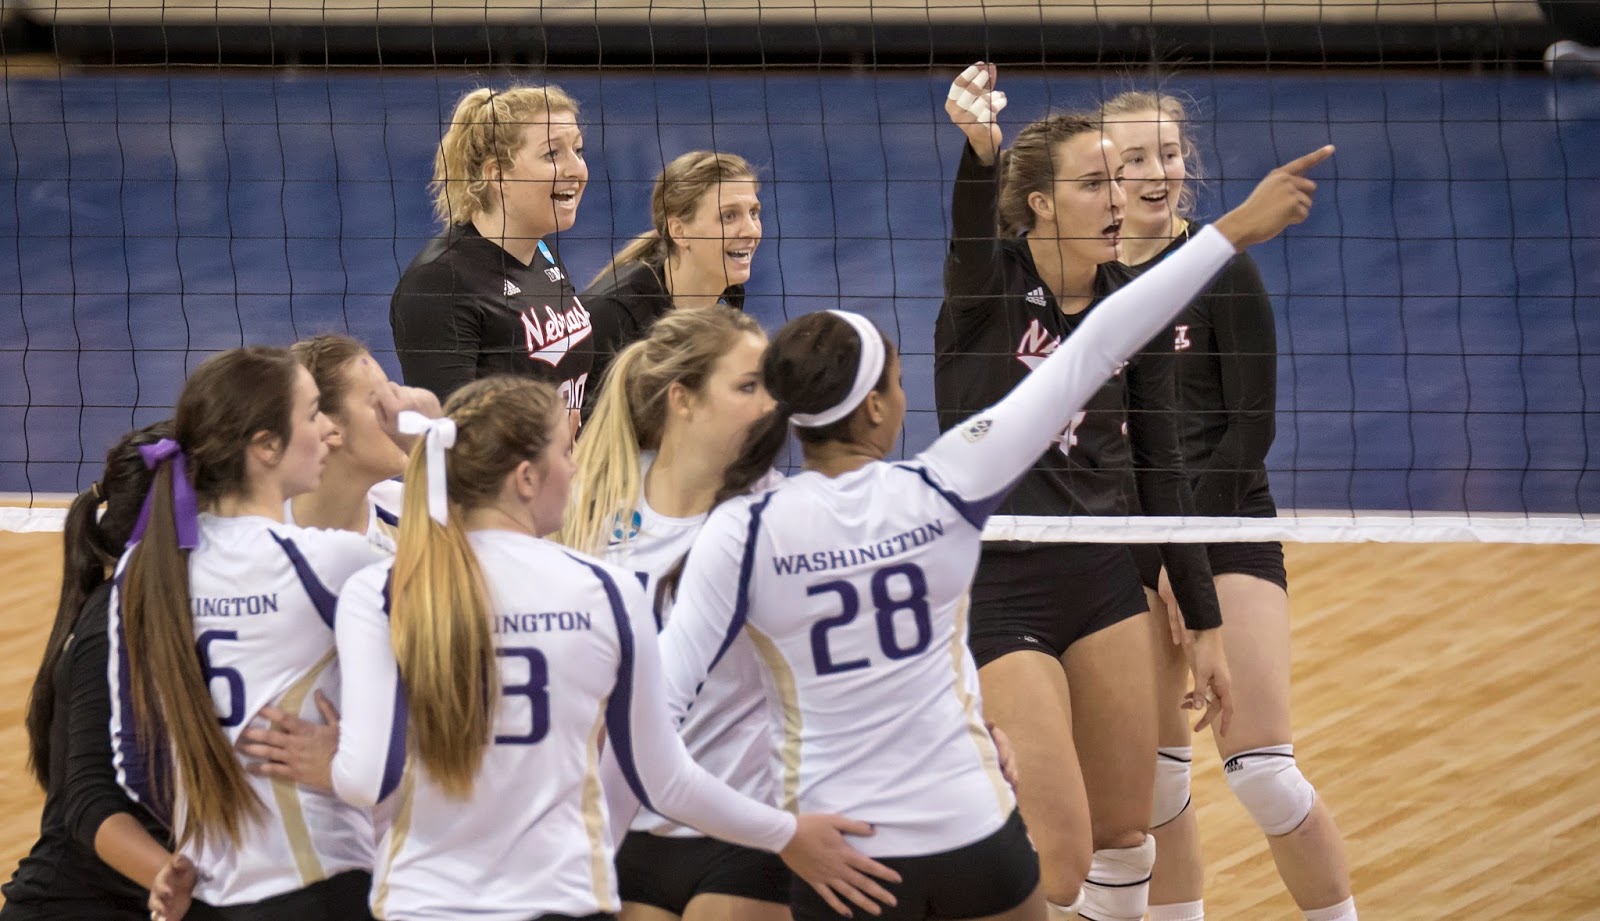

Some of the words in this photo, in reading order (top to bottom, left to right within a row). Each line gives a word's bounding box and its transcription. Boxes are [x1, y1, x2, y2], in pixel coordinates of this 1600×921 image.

[772, 519, 945, 576] WASHINGTON
[190, 593, 279, 617] INGTON
[806, 562, 933, 676] 28
[195, 629, 247, 727] 6
